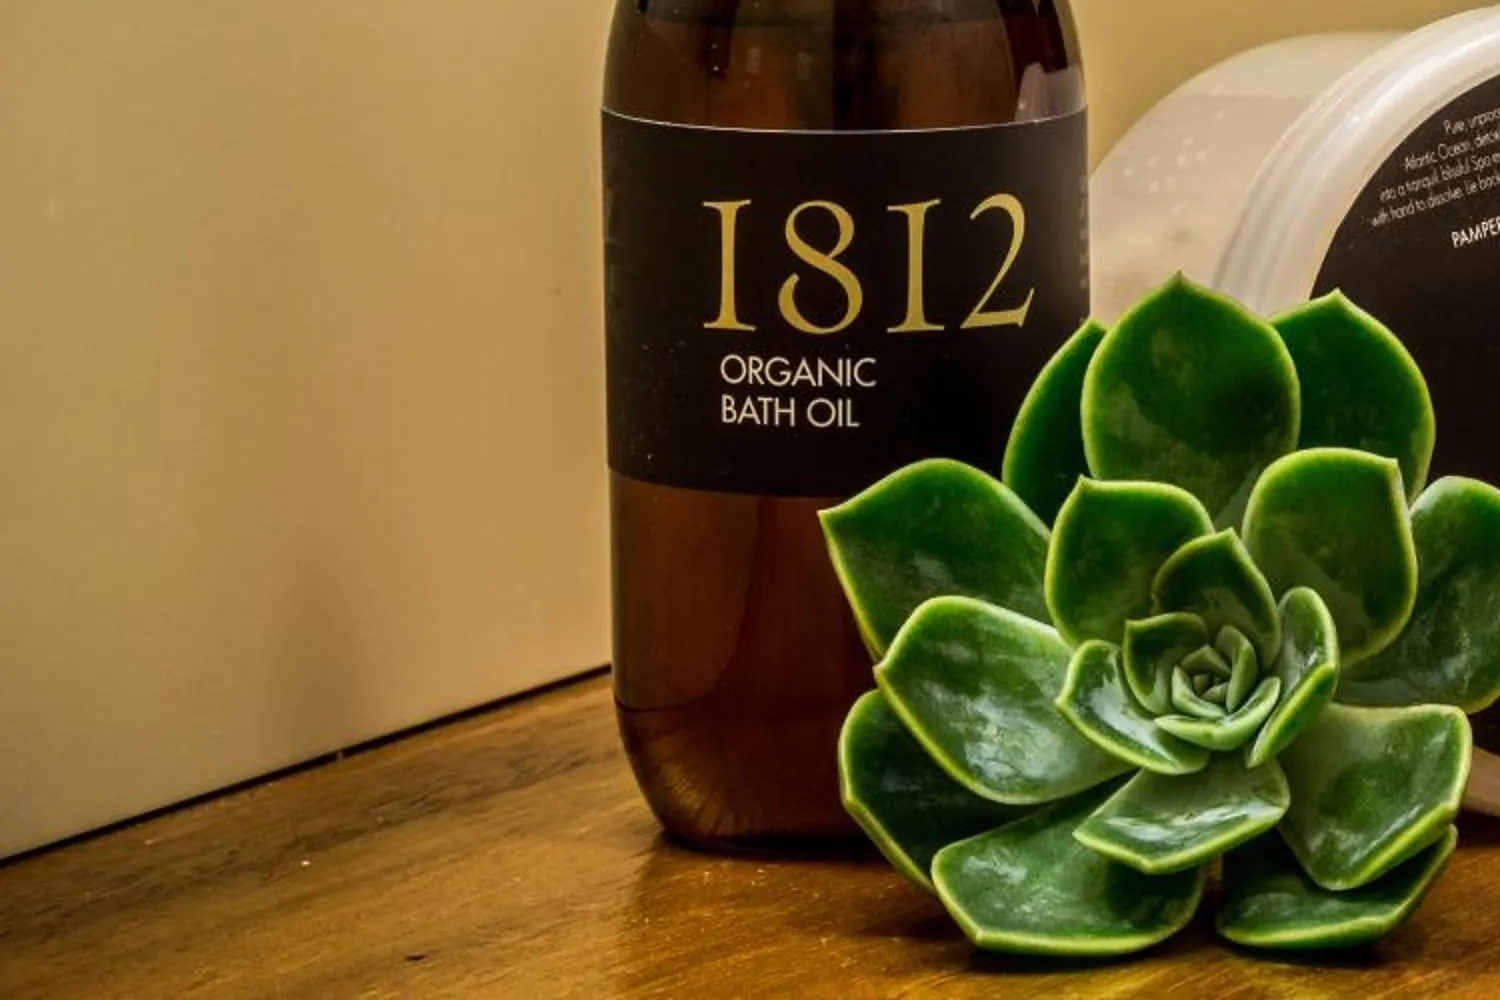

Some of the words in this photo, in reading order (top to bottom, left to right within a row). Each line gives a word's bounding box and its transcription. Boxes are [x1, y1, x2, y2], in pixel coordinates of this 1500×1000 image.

[1444, 120, 1466, 134] Pure
[1404, 153, 1435, 170] Atlantic
[1471, 156, 1491, 172] Spa
[1389, 200, 1415, 218] hand
[1415, 200, 1426, 210] to
[702, 193, 1035, 335] 1812
[720, 354, 878, 388] ORGANIC
[720, 395, 796, 426] BATH
[806, 398, 860, 427] OIL
